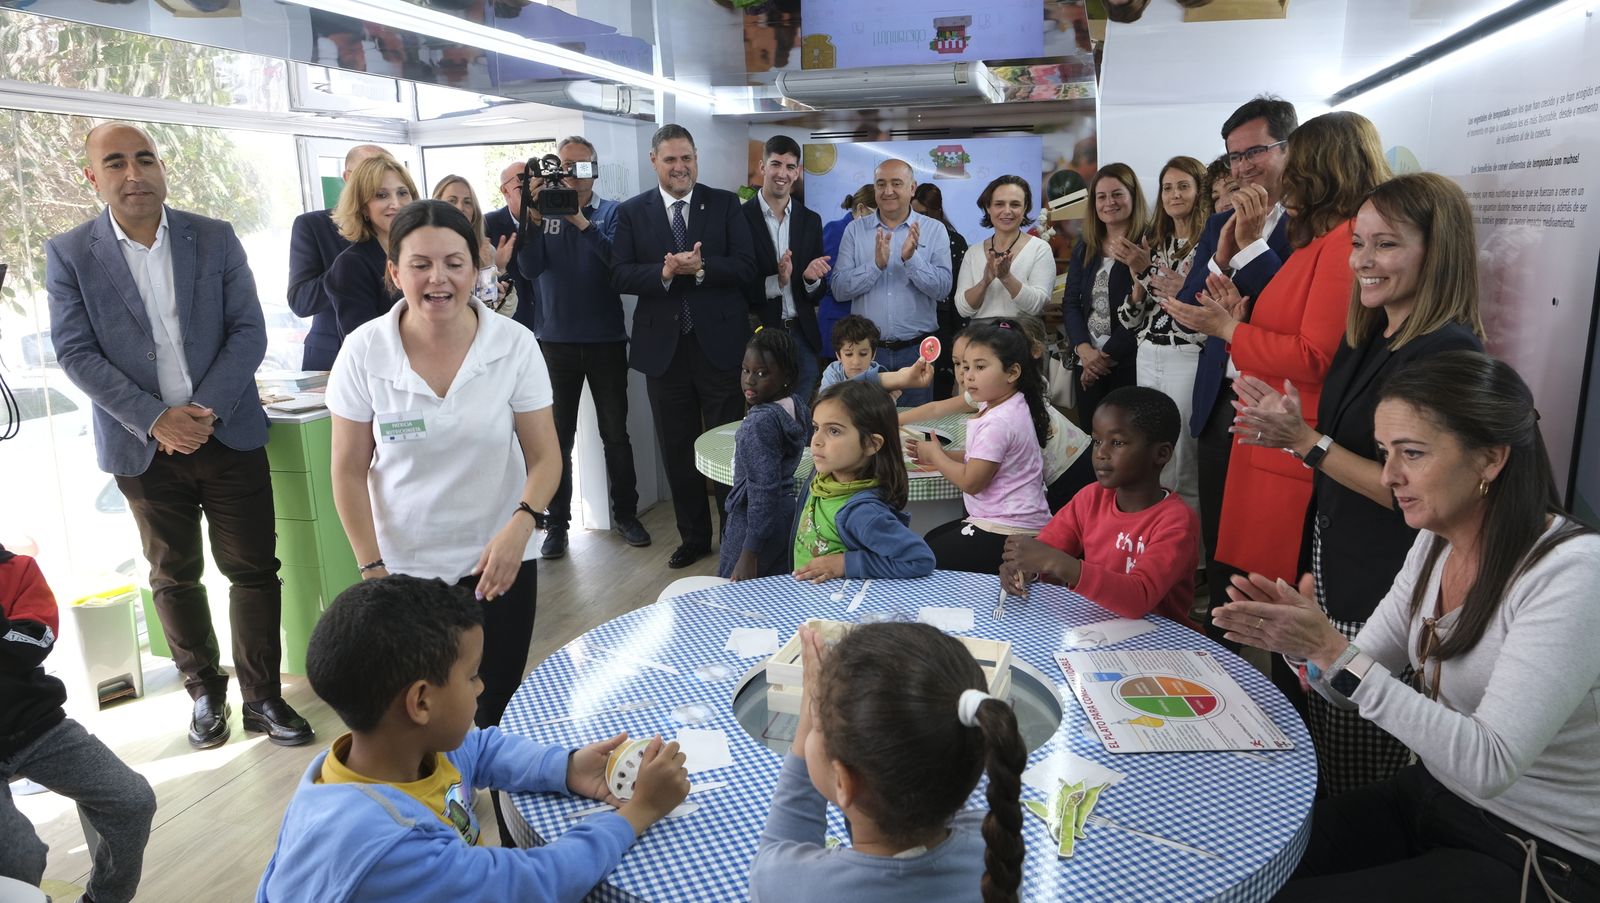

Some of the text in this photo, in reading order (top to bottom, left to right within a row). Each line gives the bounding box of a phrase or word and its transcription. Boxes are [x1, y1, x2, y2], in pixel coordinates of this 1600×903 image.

[1532, 155, 1554, 169] temporada
[1554, 157, 1562, 166] son
[1086, 704, 1103, 721] PARA
[1095, 721, 1116, 741] PLATO
[1108, 741, 1120, 749] EL
